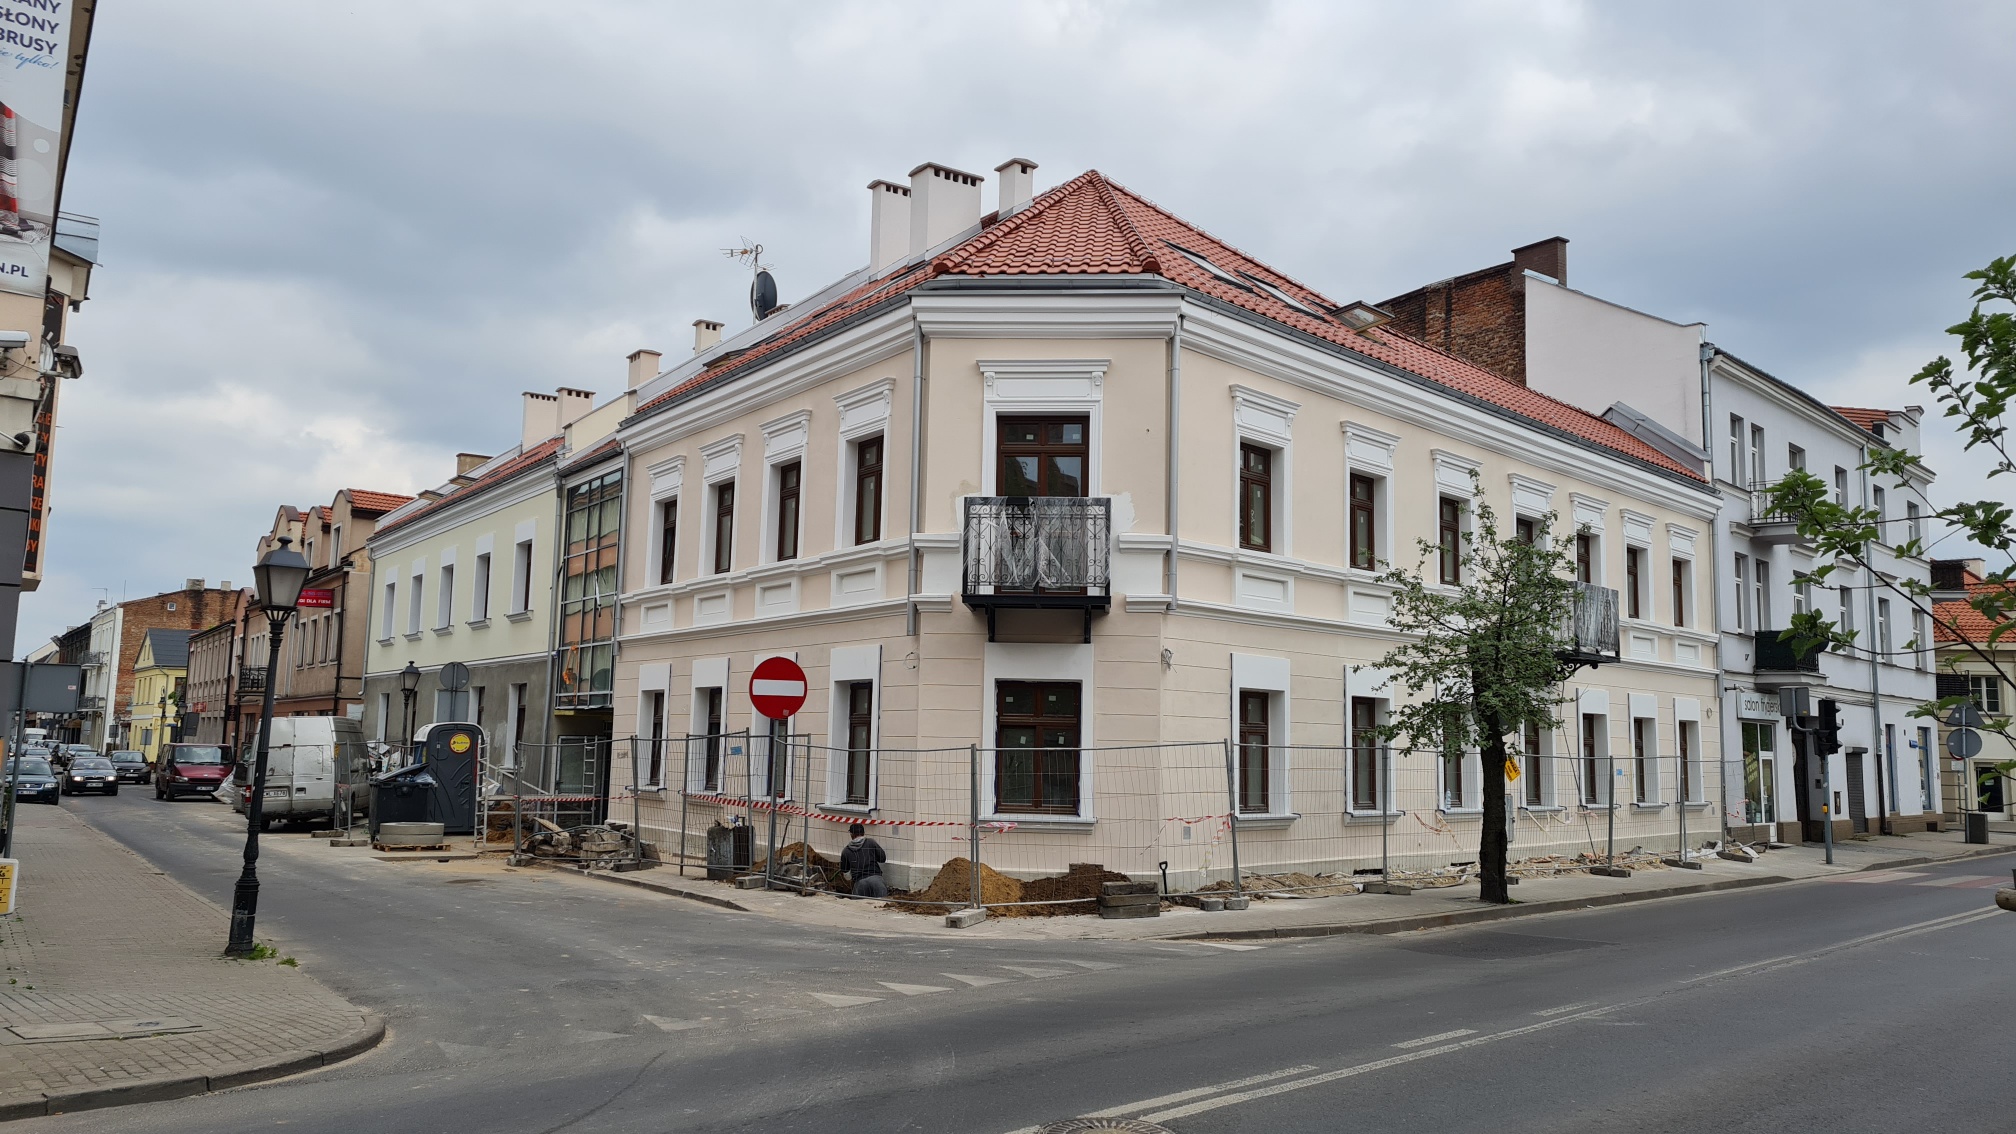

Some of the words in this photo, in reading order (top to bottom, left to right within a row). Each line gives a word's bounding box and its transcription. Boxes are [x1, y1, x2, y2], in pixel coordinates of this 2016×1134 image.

[13, 0, 61, 14] ANY
[15, 53, 60, 69] tylko!
[1744, 697, 1760, 712] salon
